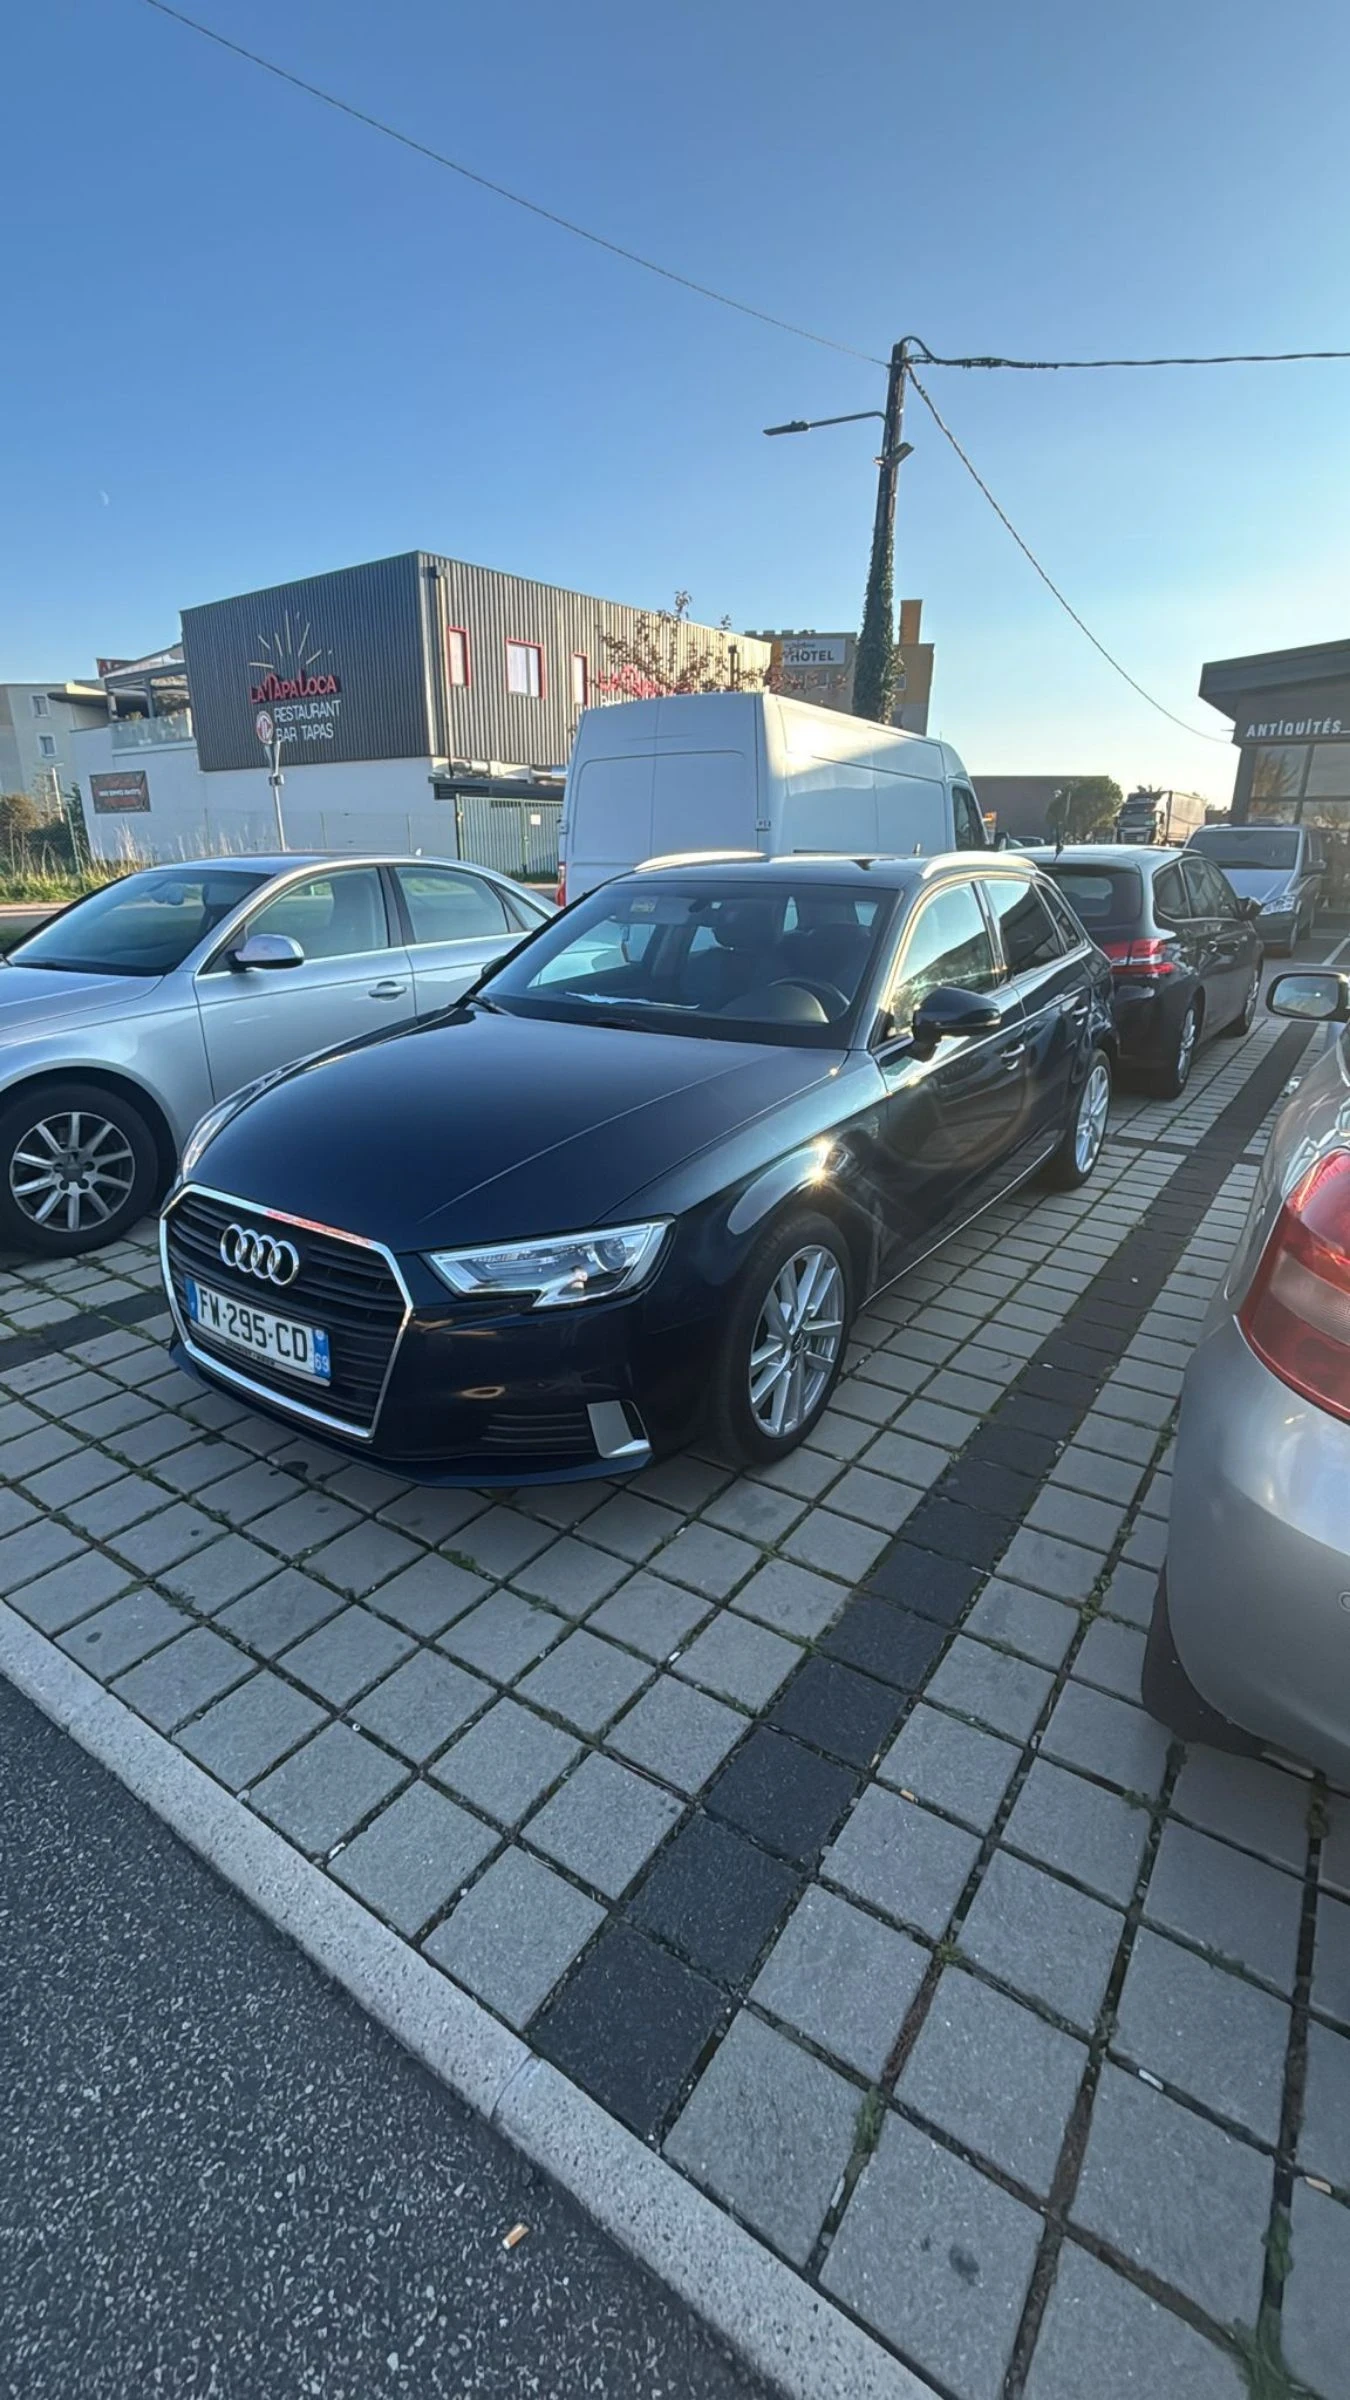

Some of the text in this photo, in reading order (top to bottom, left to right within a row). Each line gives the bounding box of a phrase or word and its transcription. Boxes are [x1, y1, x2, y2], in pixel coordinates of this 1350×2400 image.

[790, 649, 835, 662] HOTEL
[249, 686, 266, 704] LA
[298, 668, 338, 697] LOCA
[274, 700, 341, 723] RESTAURANT
[276, 727, 298, 743] BAR
[301, 723, 334, 741] TAPAS
[315, 1352, 330, 1373] 69
